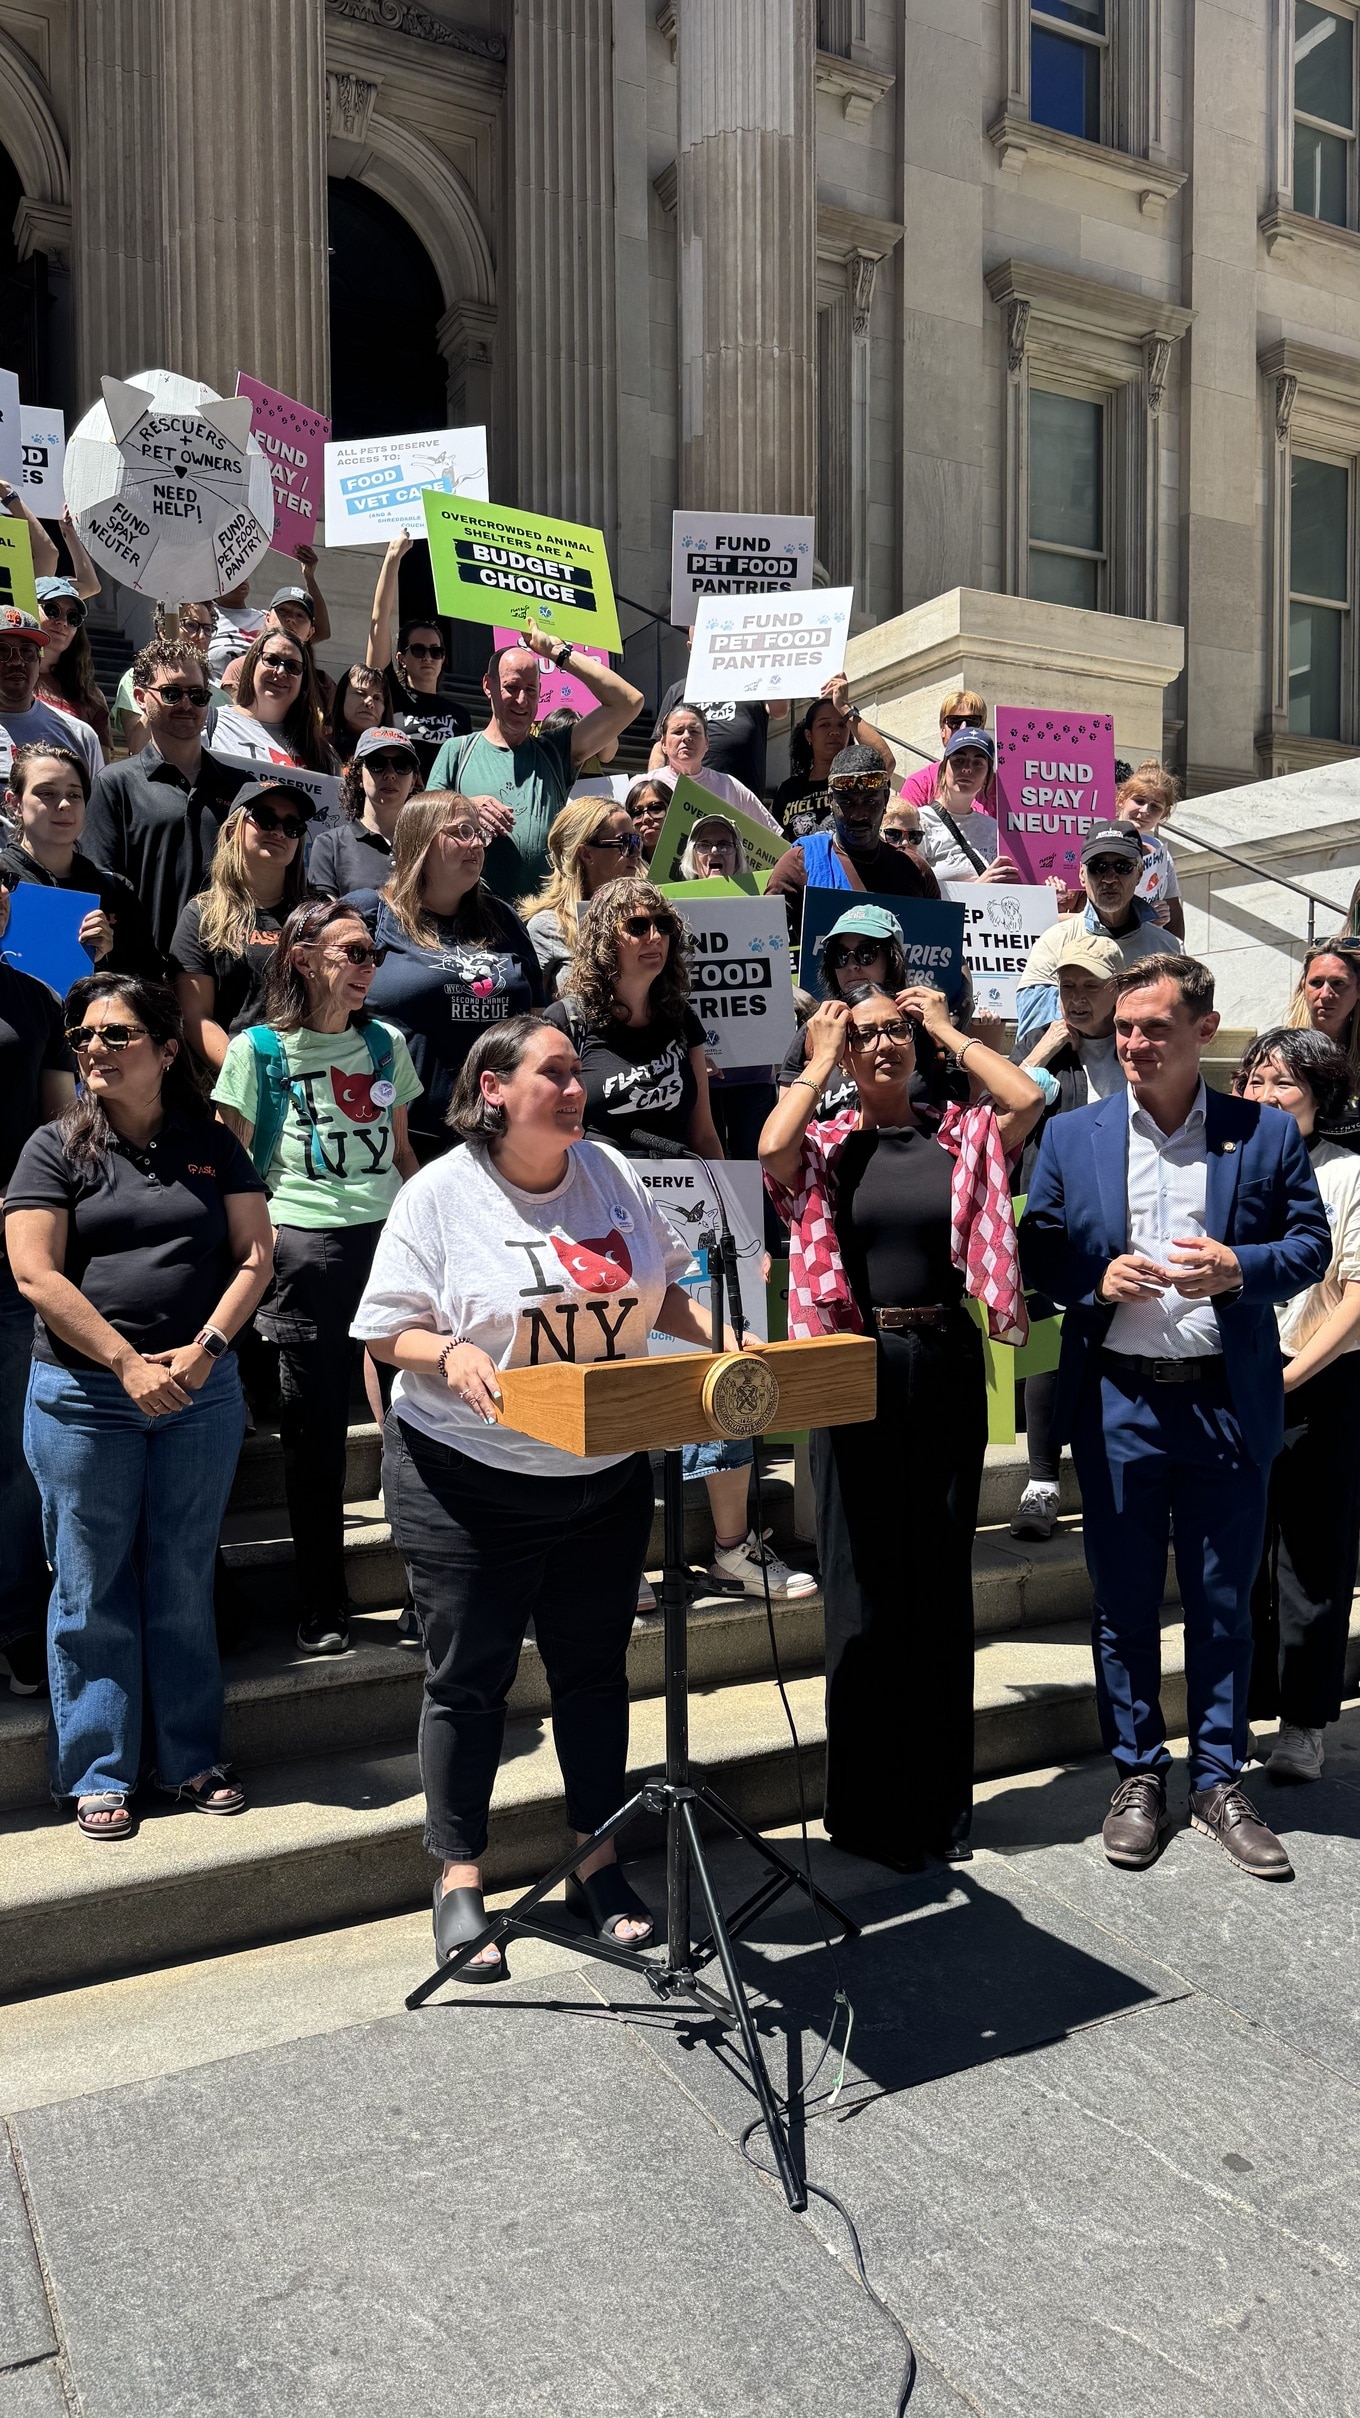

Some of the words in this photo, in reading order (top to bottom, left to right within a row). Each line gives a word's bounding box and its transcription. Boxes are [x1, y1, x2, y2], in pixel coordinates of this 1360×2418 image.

[139, 417, 227, 451] RESCUERS
[141, 443, 177, 462] PET
[180, 450, 243, 474] OWNERS
[255, 429, 309, 469] FUND
[337, 449, 358, 457] ALL
[360, 446, 388, 455] PETS
[390, 439, 441, 452] DESERVE
[337, 456, 380, 466] ACCESS
[346, 470, 397, 491] FOOD
[153, 484, 198, 503] NEED
[353, 493, 391, 511] VET
[112, 502, 150, 536] FUND
[153, 500, 203, 524] HELP!
[106, 515, 140, 545] SPAY
[217, 513, 247, 549] FUND
[441, 510, 543, 541] OVERCROWDED
[546, 535, 595, 554] ANIMAL
[88, 519, 141, 568] NEUTER
[217, 543, 237, 569] PET
[236, 519, 257, 550] FOOD
[225, 529, 263, 581] PANTRY
[464, 527, 532, 549] SHELTERS
[536, 543, 562, 557] ARE
[565, 550, 574, 560] A
[715, 535, 771, 552] FUND
[472, 543, 575, 581] BUDGET
[692, 556, 731, 573] PET
[737, 558, 793, 575] FOOD
[479, 568, 577, 605] CHOICE
[692, 578, 792, 594] PANTRIES
[742, 612, 804, 629] FUND
[714, 635, 759, 651] PET
[763, 630, 826, 649] FOOD
[711, 651, 823, 671] PANTRIES
[1024, 760, 1094, 783] FUND
[1021, 786, 1084, 809] SPAY
[1006, 811, 1108, 836] NEUTE
[689, 932, 729, 954] ND
[446, 984, 460, 993] NYC
[451, 995, 480, 1004] SECOND
[482, 996, 510, 1005] CHANCE
[451, 1003, 509, 1019] RESCUE
[602, 1039, 687, 1099] FLATBUSH
[288, 1070, 334, 1126] I
[636, 1079, 682, 1109] CATS
[296, 1126, 390, 1181] NY
[641, 1176, 695, 1188] SERVE
[504, 1240, 565, 1298] I
[522, 1297, 639, 1367] NY
